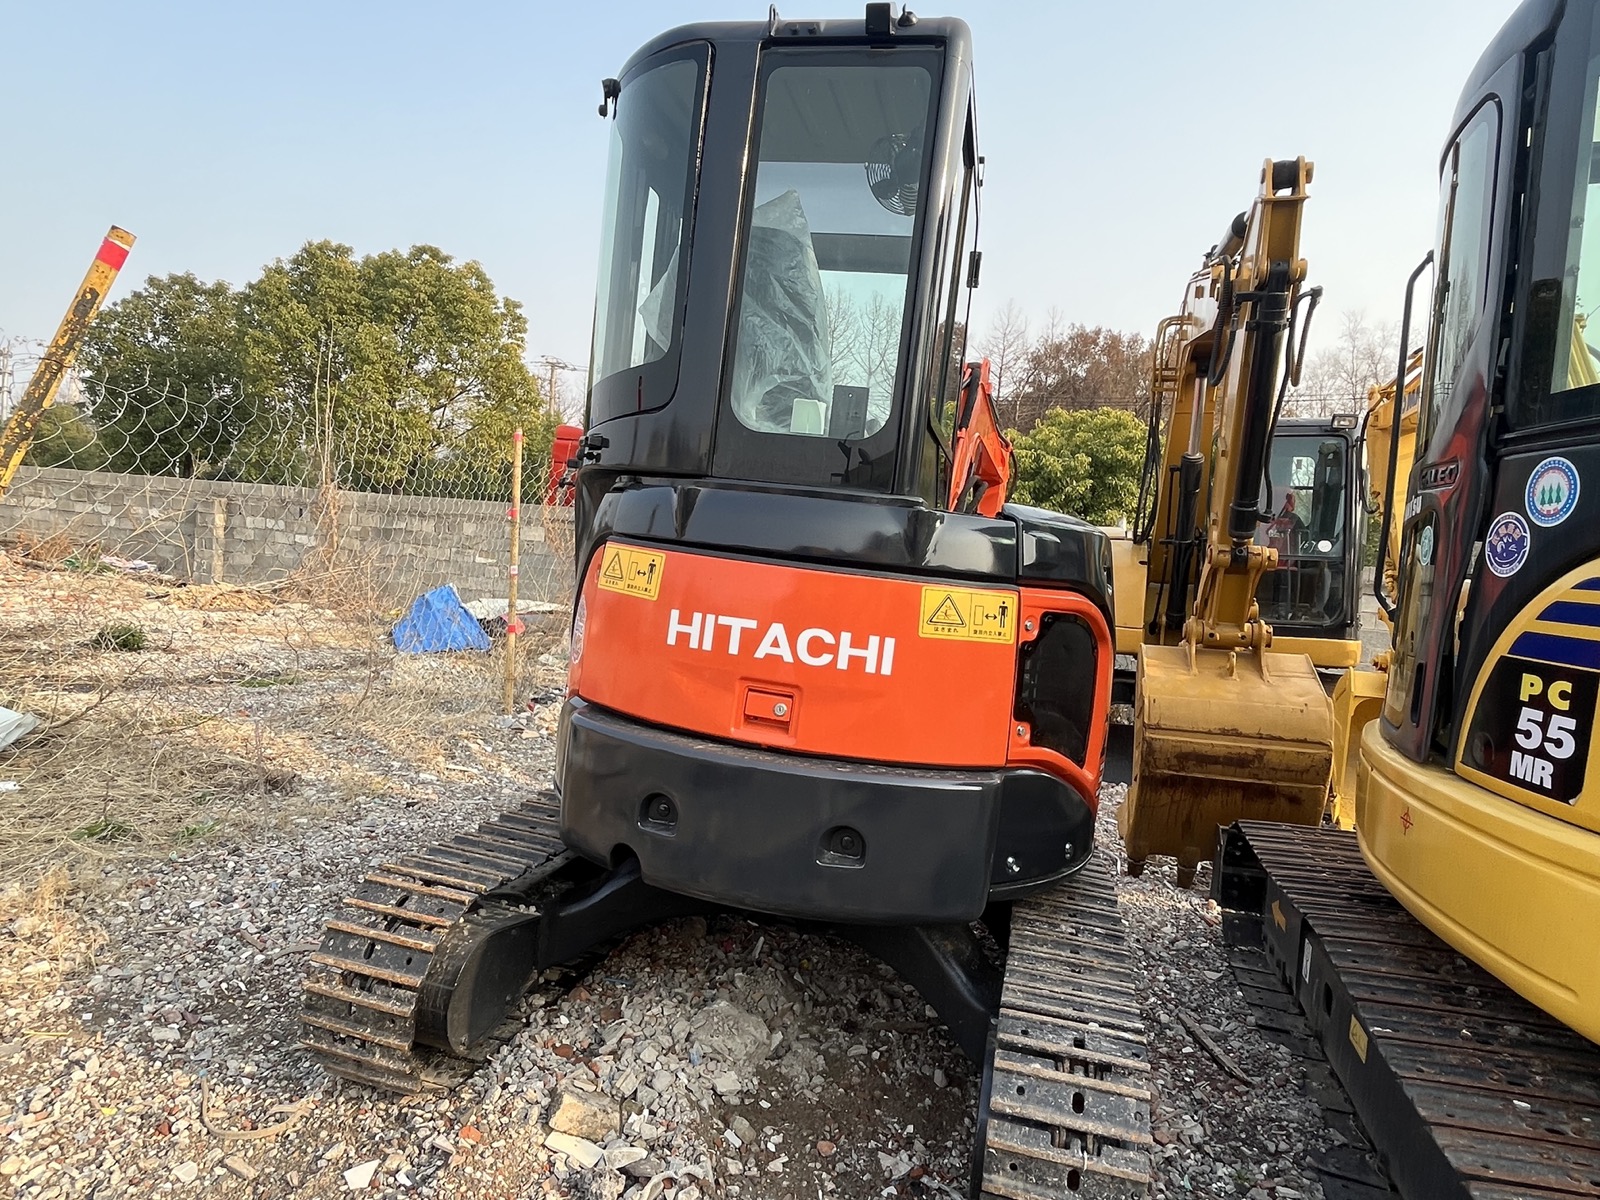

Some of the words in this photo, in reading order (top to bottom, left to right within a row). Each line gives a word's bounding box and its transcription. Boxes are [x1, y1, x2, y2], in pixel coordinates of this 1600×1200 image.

[666, 608, 896, 676] HITACHI
[1519, 672, 1573, 711] PC
[1514, 706, 1577, 760] 55
[1509, 750, 1554, 789] MR
